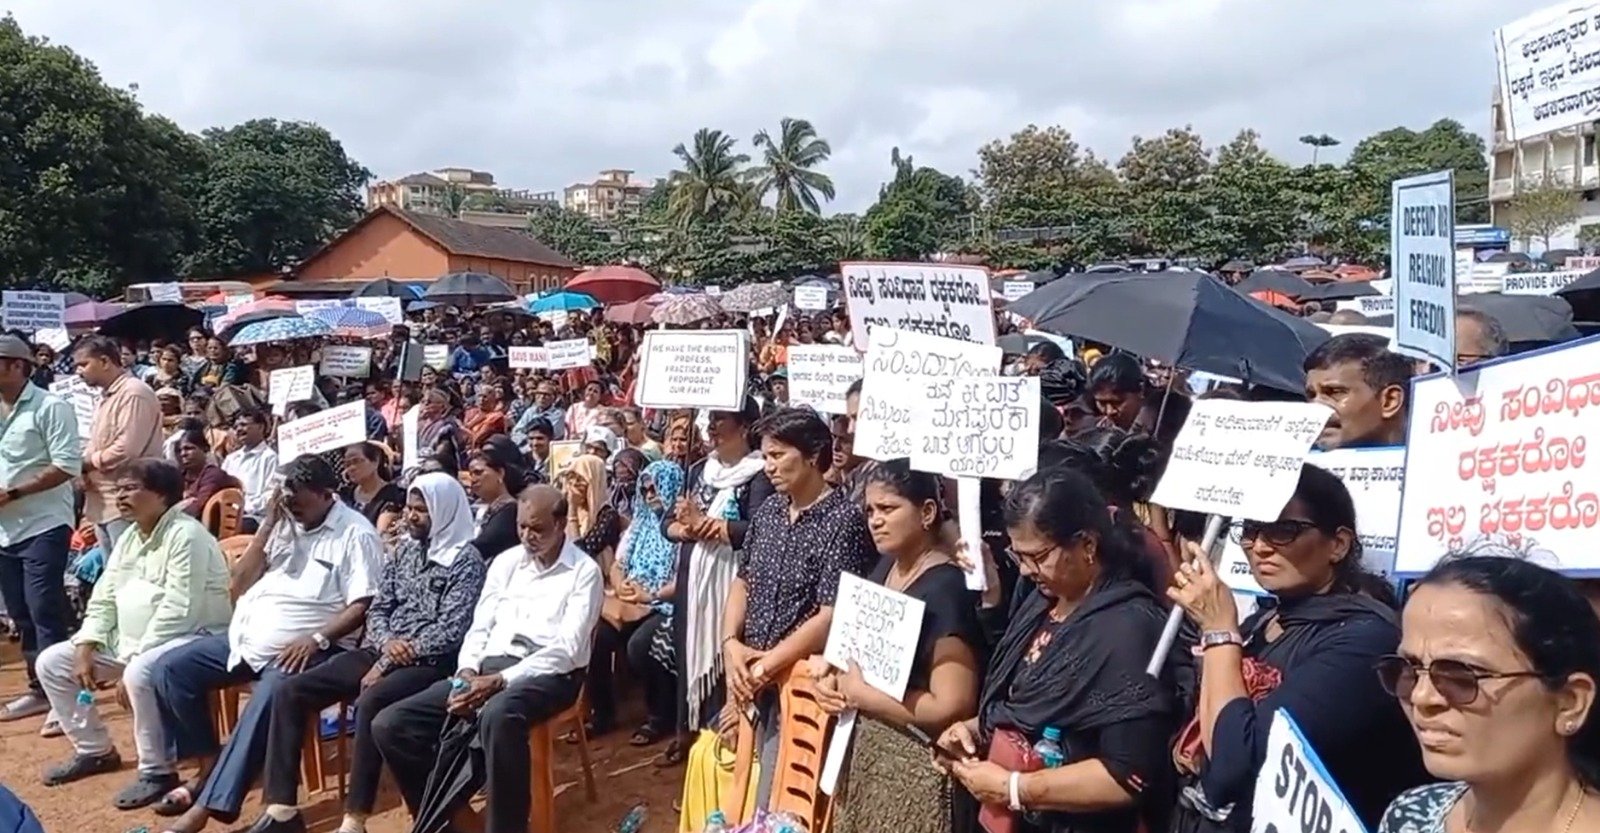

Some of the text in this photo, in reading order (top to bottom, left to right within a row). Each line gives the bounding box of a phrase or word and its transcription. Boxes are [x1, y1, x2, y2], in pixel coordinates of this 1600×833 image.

[1403, 205, 1436, 236] DEFEND
[877, 269, 927, 305] ಸಂವಿಧಾನ
[1505, 276, 1548, 291] PROVIDE
[652, 344, 664, 353] WE
[665, 344, 685, 354] HAVE
[687, 344, 702, 354] THE
[664, 364, 721, 375] PRACTICE AND
[668, 386, 711, 395] OUR FAITH
[1429, 390, 1487, 438] ನೀವು
[1457, 426, 1587, 495] ರಕ್ಷಕರೋ
[1426, 504, 1468, 551] ಇಲ್ಲ
[1274, 742, 1333, 833] STOP
